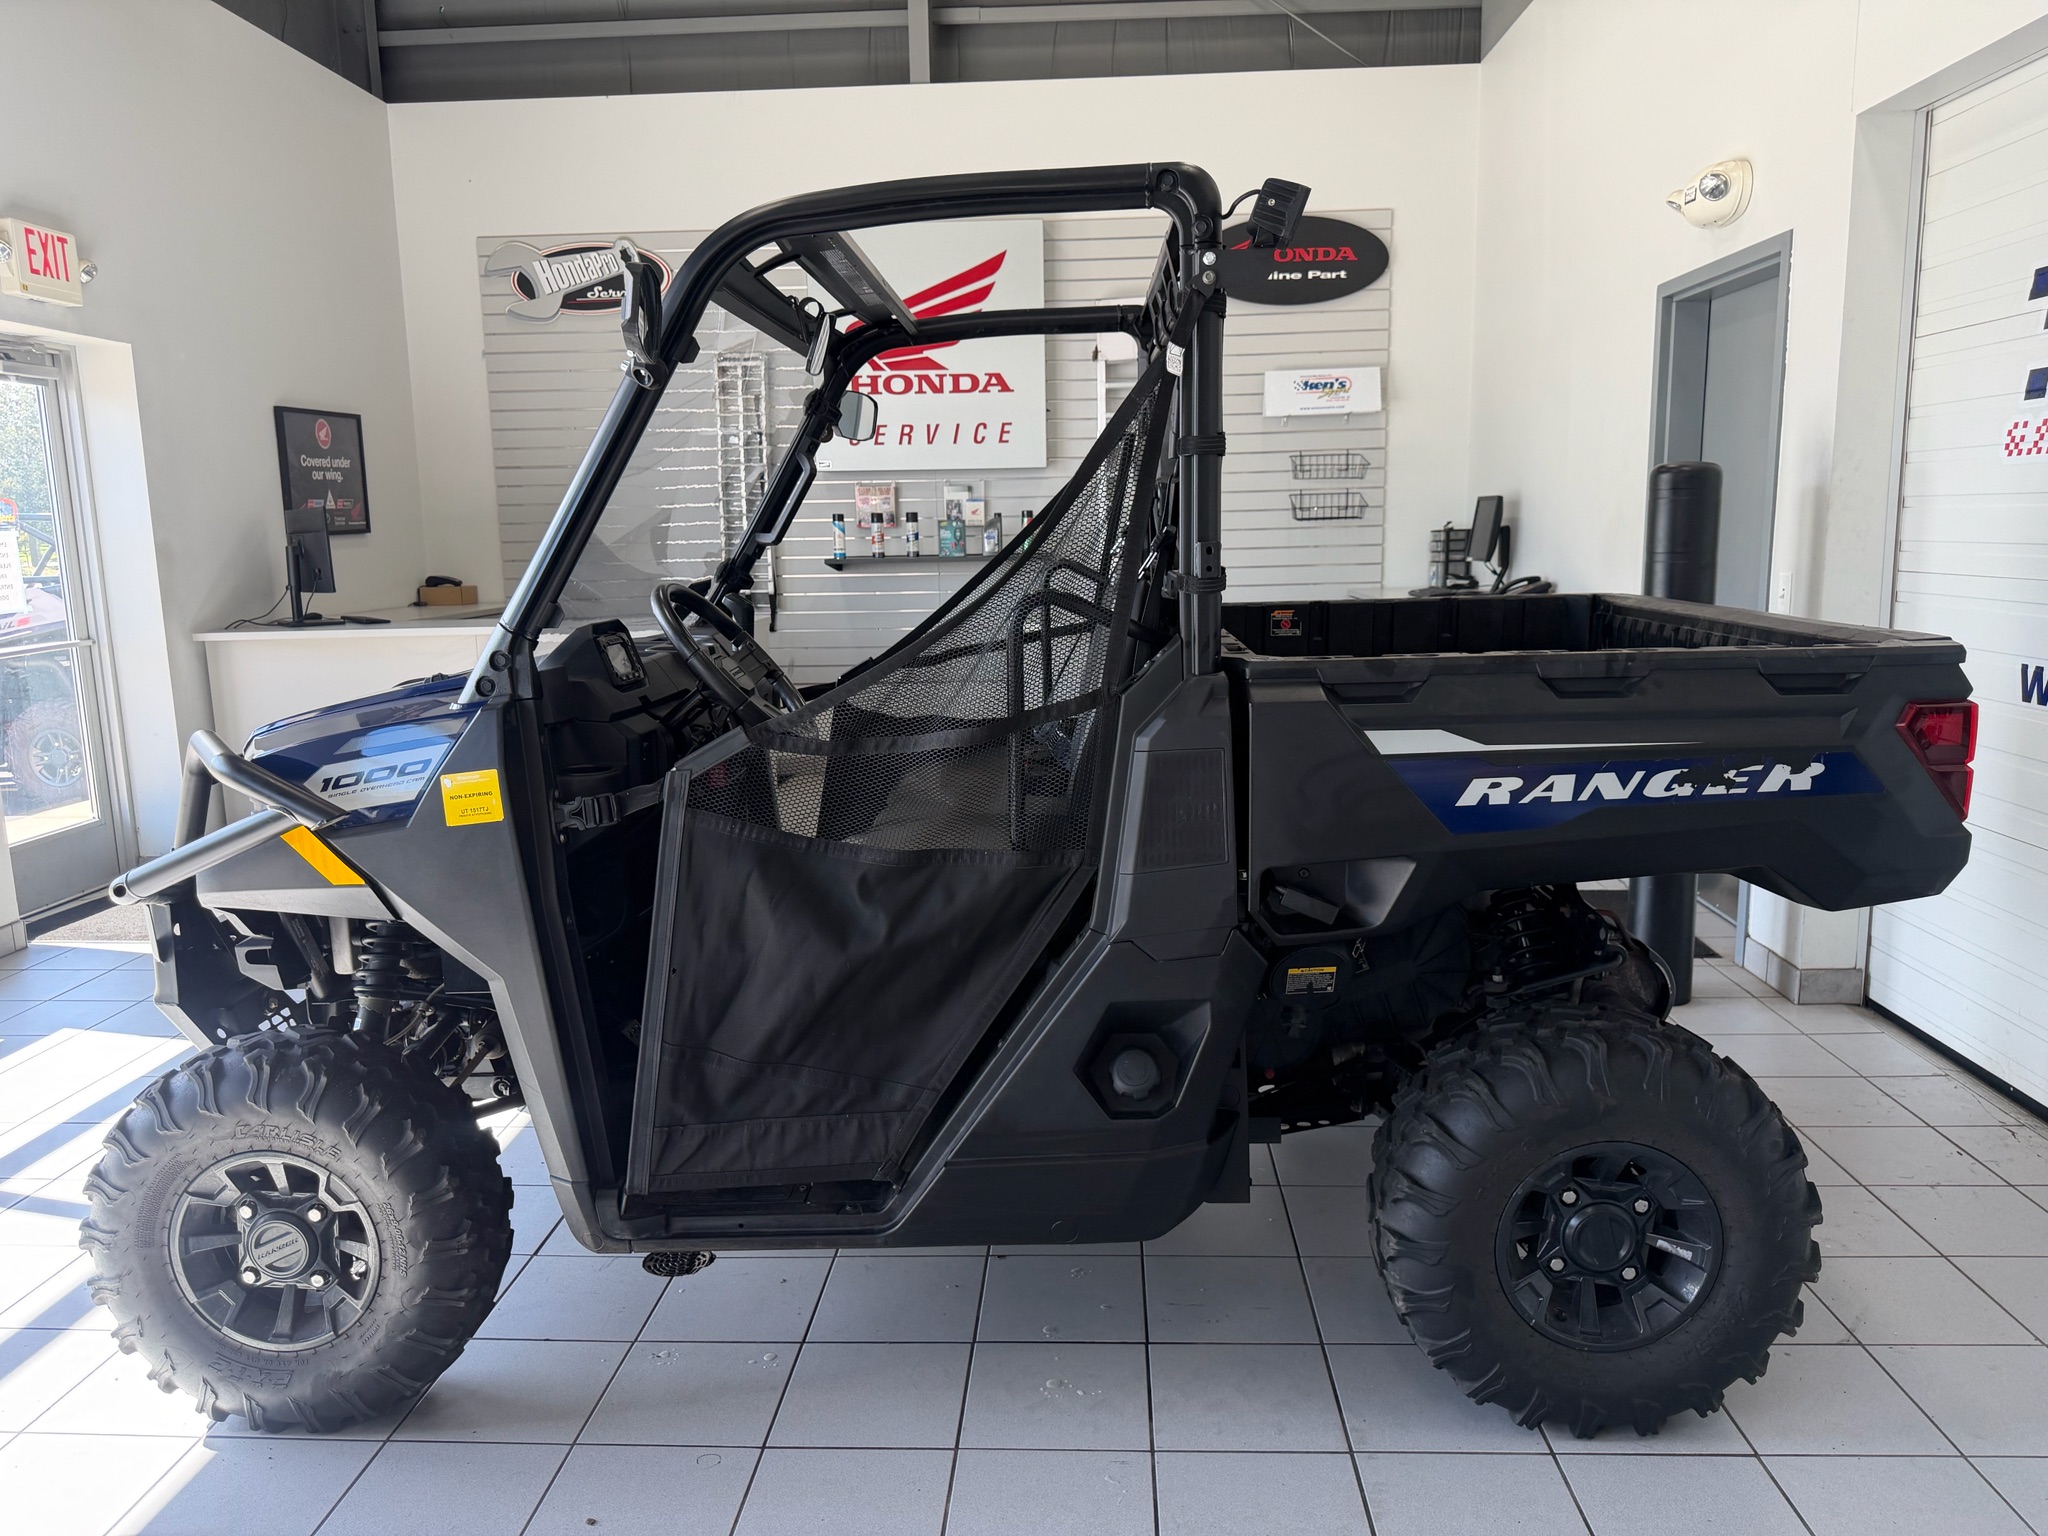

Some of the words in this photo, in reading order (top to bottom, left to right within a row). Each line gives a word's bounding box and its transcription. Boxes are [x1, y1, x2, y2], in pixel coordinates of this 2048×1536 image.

[24, 226, 70, 283] EXIT
[1273, 247, 1358, 262] ONDA
[532, 251, 621, 296] HondaPro
[1307, 269, 1347, 280] Part
[586, 285, 627, 300] Serv
[851, 373, 1015, 395] HONDA
[849, 422, 1013, 446] ERVICE
[300, 454, 331, 468] Covered
[331, 457, 351, 468] under
[312, 469, 324, 481] our
[325, 469, 344, 483] wing.
[2021, 663, 2048, 707] W
[320, 758, 433, 793] 1000
[1455, 762, 1825, 806] RANGER
[328, 789, 358, 799] SINGLE
[360, 780, 405, 793] OVERHEAD
[406, 776, 426, 785] CAM
[450, 791, 493, 801] NON-EXPIRING
[235, 1123, 342, 1159] CARLISLE
[257, 1238, 299, 1260] RANGER
